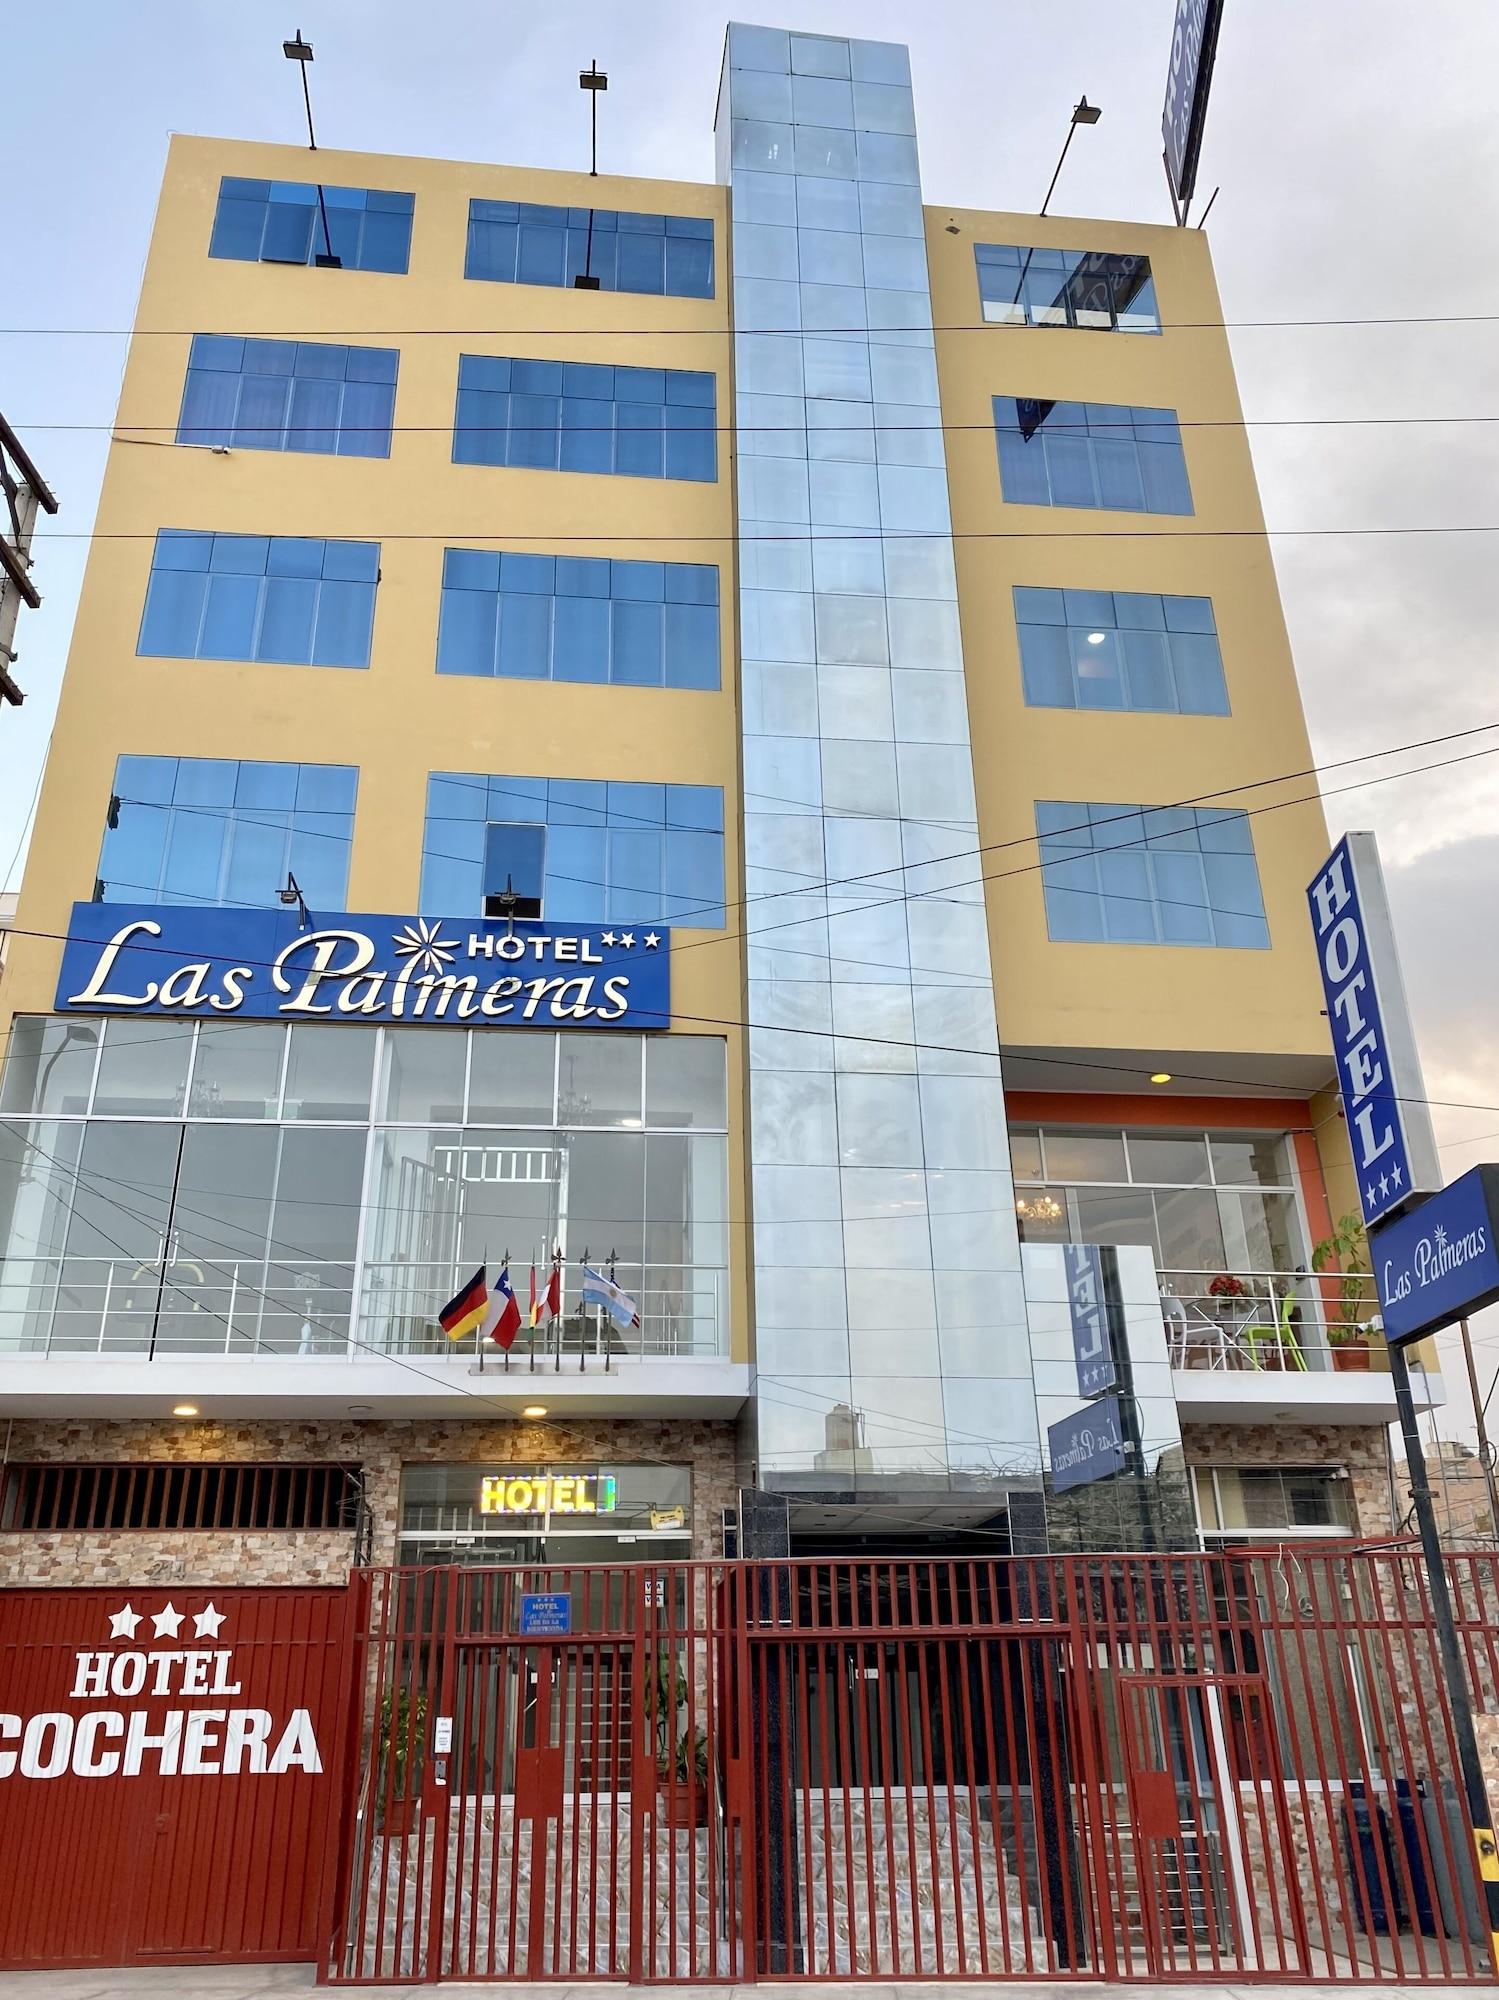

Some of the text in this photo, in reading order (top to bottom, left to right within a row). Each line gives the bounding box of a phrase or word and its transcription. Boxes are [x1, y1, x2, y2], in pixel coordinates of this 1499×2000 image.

[68, 920, 630, 1020] Las Palmeras
[468, 933, 603, 964] HOTEL
[1313, 851, 1395, 1169] HOTEL
[1384, 1226, 1486, 1307] Las Palmeras
[480, 1478, 596, 1512] HOTEL
[69, 1650, 242, 1698] HOTEL
